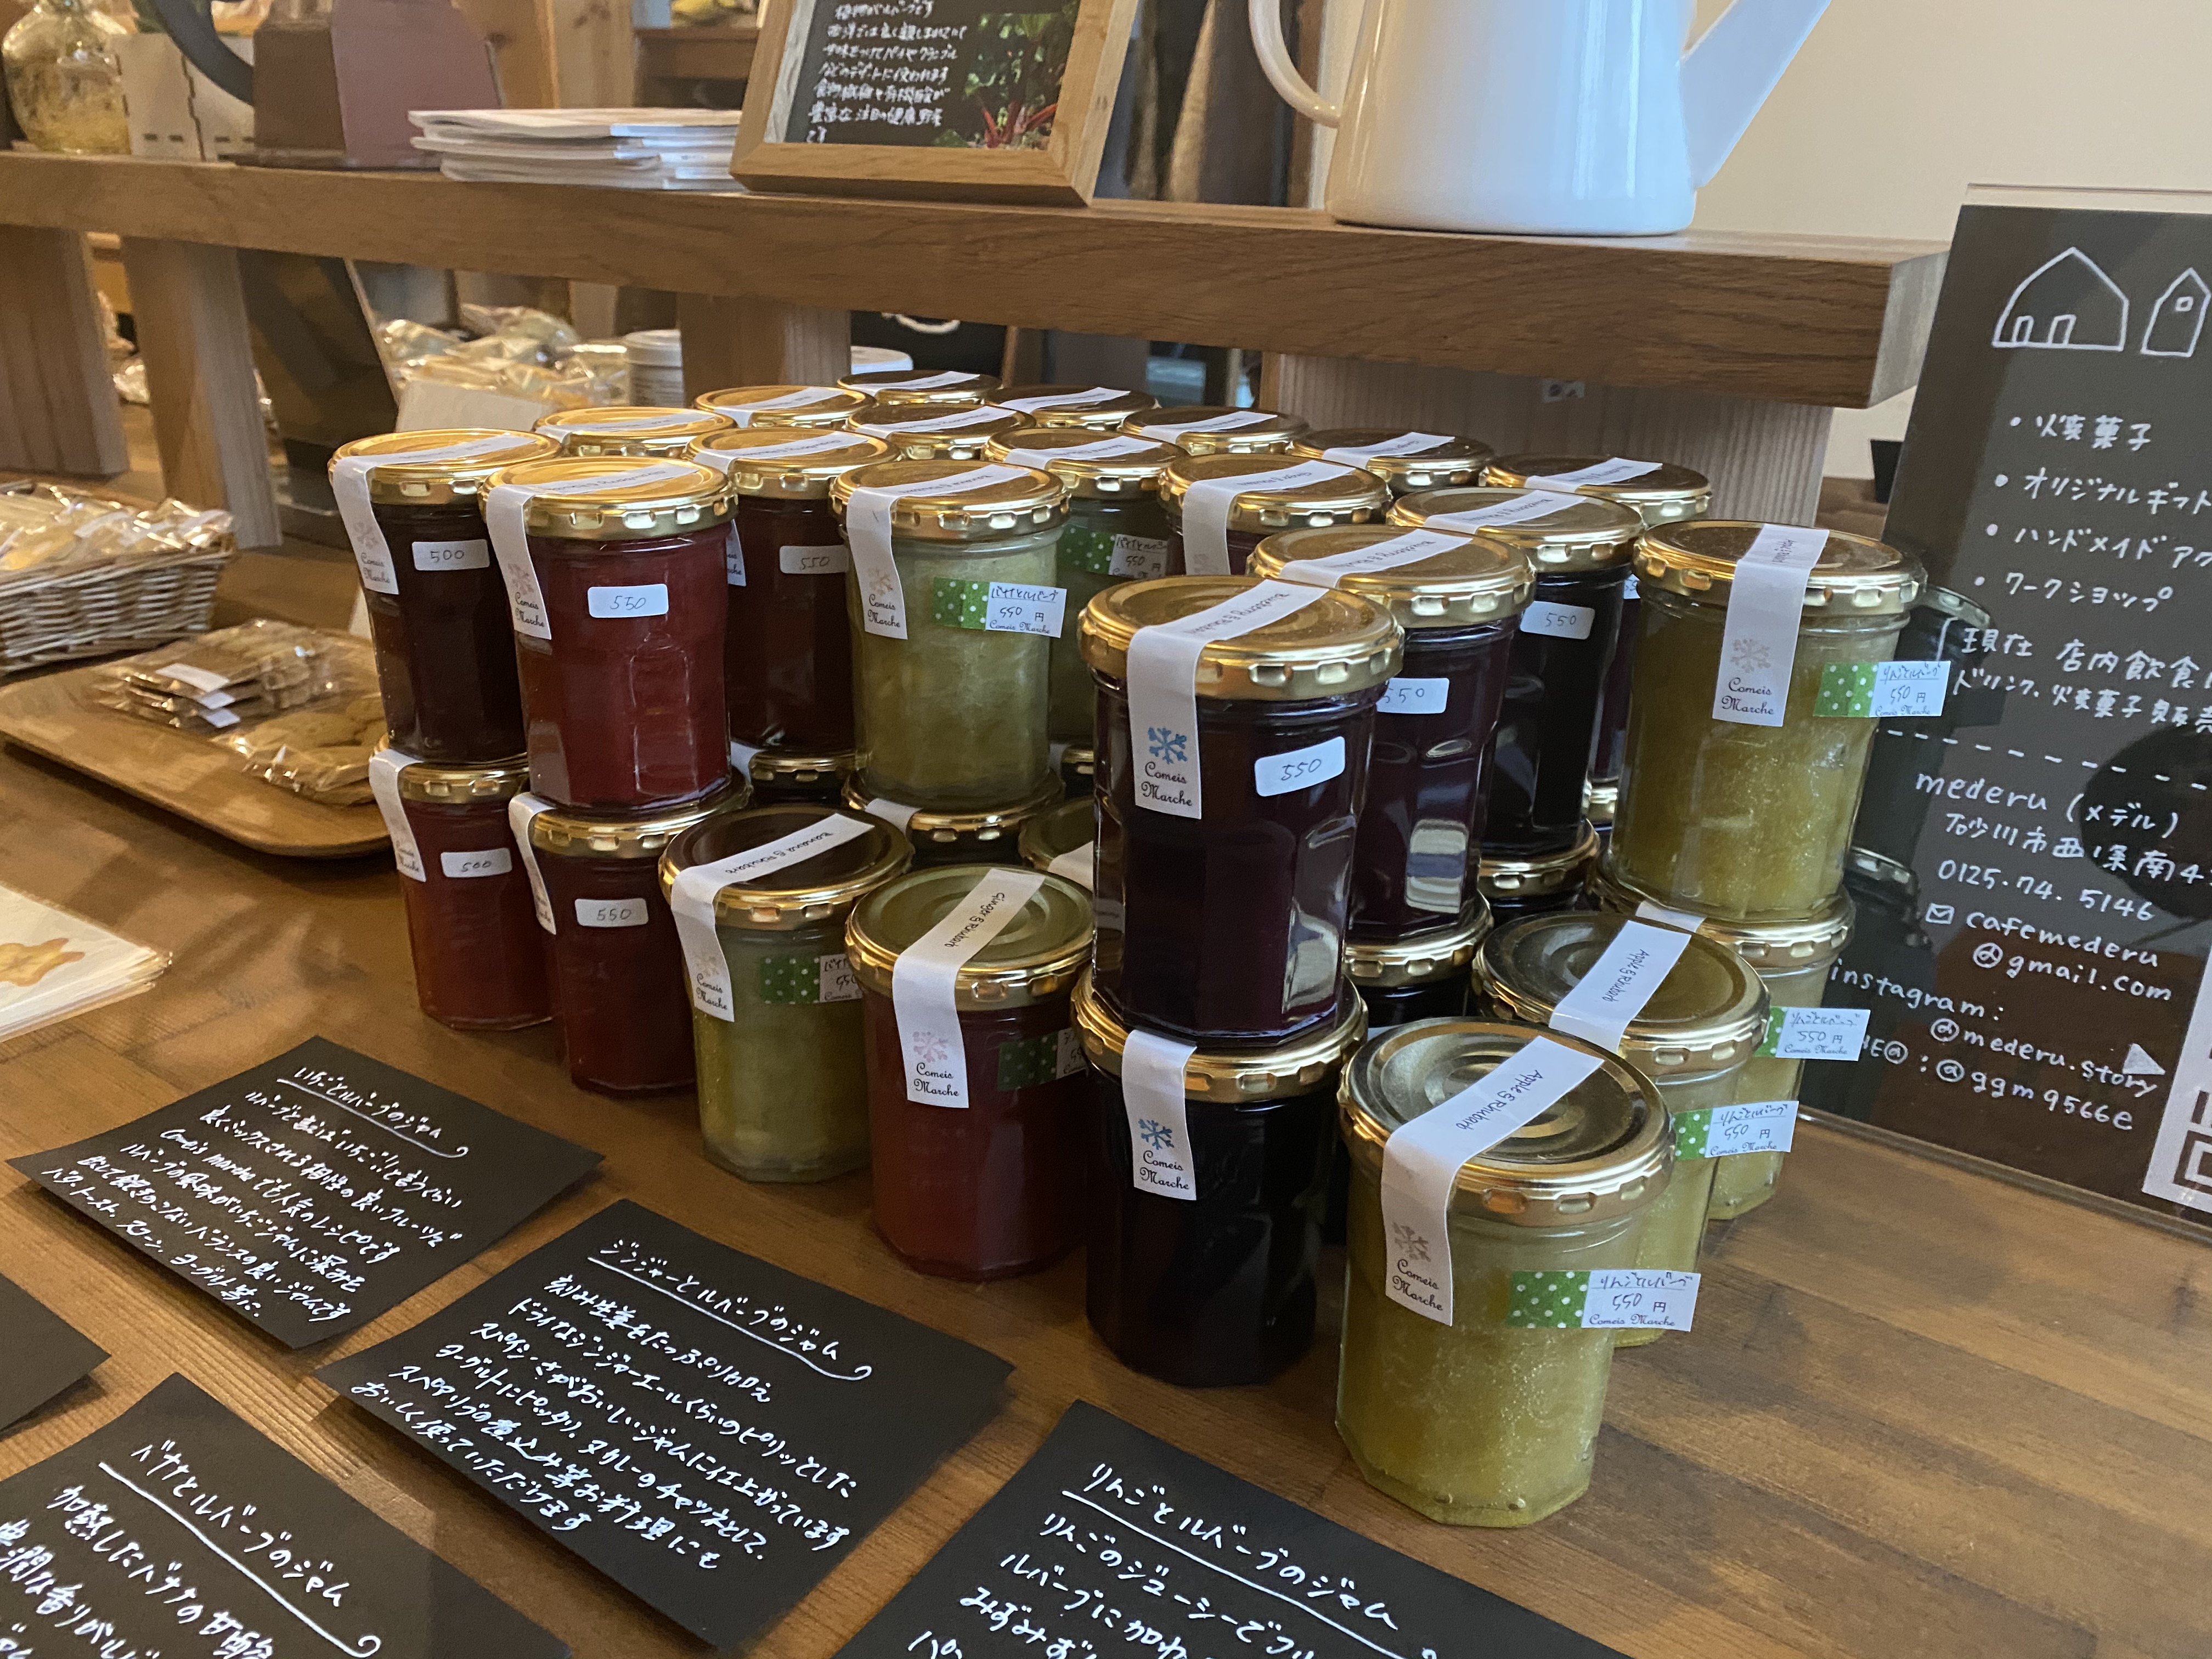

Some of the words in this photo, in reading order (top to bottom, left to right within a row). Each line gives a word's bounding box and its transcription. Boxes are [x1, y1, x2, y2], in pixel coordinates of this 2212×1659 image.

[2024, 467, 2211, 515] オリジナルギフト
[430, 550, 465, 563] 500
[800, 556, 830, 571] 550
[610, 595, 646, 611] 550
[2006, 573, 2174, 612] ワークショップ
[515, 607, 545, 628] Marche
[867, 610, 900, 628] Marche
[1000, 607, 1022, 618] 550
[1035, 612, 1044, 623] 円
[1544, 612, 1577, 628] 550
[1963, 627, 2033, 657] 現在
[1728, 676, 1773, 696] Comeis
[1891, 686, 1911, 705] 550
[1916, 692, 1926, 703] 円
[1721, 695, 1774, 715] Marche
[1145, 761, 1187, 785] Comeis
[1280, 758, 1322, 781] 550
[1141, 781, 1193, 806] Marche
[1915, 772, 2047, 811] mederu
[785, 831, 833, 854] Banana
[1945, 812, 2212, 884] 砂川市西1条南4
[462, 860, 492, 872] 500
[596, 908, 631, 922] 550
[980, 891, 1006, 918] Ginger
[1966, 911, 2159, 967] cafemederu
[1628, 948, 1650, 970] Apple
[1973, 942, 2171, 1002] @gmail.com
[696, 989, 727, 1011] Marche
[1797, 1030, 1826, 1043] 550
[1833, 1034, 1843, 1044] 円
[1930, 1018, 2157, 1098] @mederu.story
[916, 1062, 954, 1080] Comeis
[1514, 1069, 1544, 1094] Apple
[913, 1078, 960, 1097] Marche
[294, 1067, 442, 1138] いちごとルバーブのジャム
[1724, 1125, 1749, 1138] 550
[1759, 1128, 1770, 1139] 円
[1143, 1150, 1183, 1172] Comeis
[1139, 1166, 1189, 1191] Marche
[1396, 1259, 1440, 1290] Comeis
[600, 1239, 840, 1360] ジンジャーとルバーブのジャム
[1391, 1276, 1444, 1312] Marche
[1612, 1293, 1643, 1311] 550
[1652, 1300, 1667, 1312] 円
[131, 1439, 350, 1607] バナナとルバーブのジャム
[1082, 1463, 1398, 1630] りんごとルバーブのジャム
